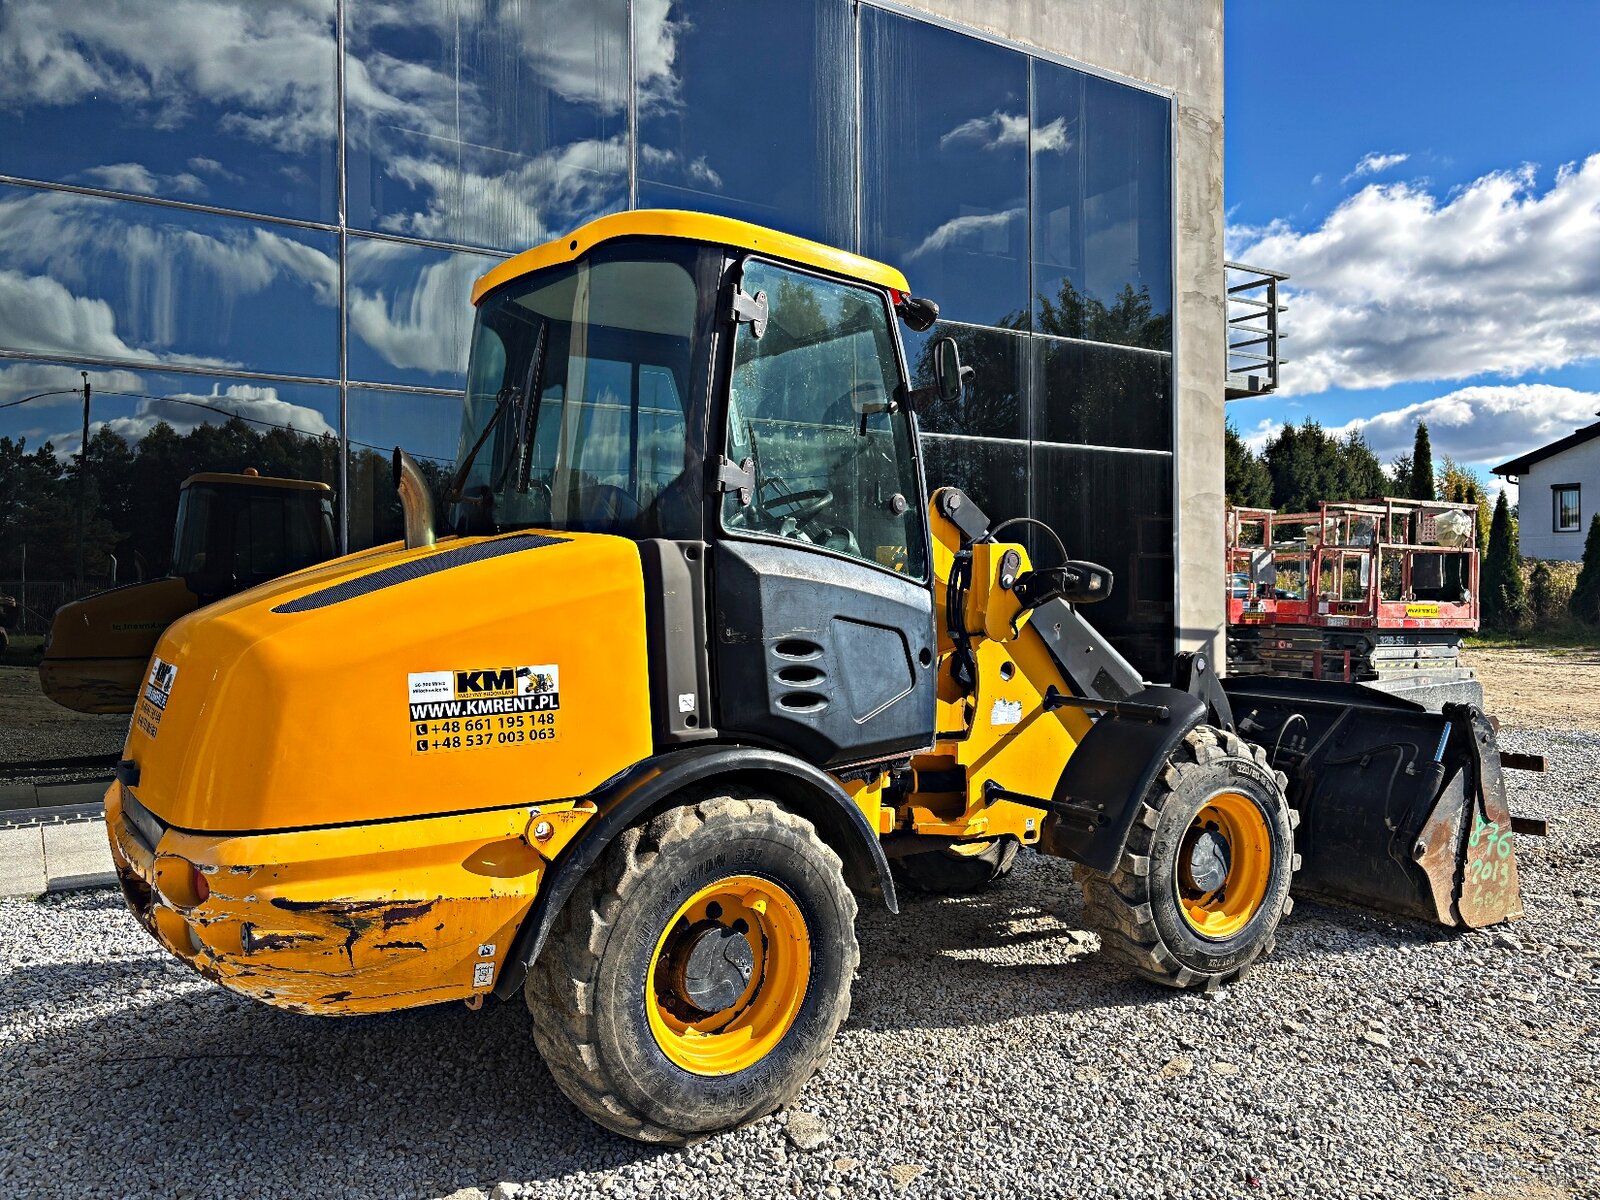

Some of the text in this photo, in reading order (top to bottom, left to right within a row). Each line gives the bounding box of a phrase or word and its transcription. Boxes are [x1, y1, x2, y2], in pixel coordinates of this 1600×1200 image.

[457, 669, 515, 693] KM
[410, 694, 559, 720] WWW.KMRENT.PL
[431, 712, 555, 735] +48 661 195 148
[431, 728, 556, 750] +48 537 003 063
[1469, 814, 1513, 860] 876
